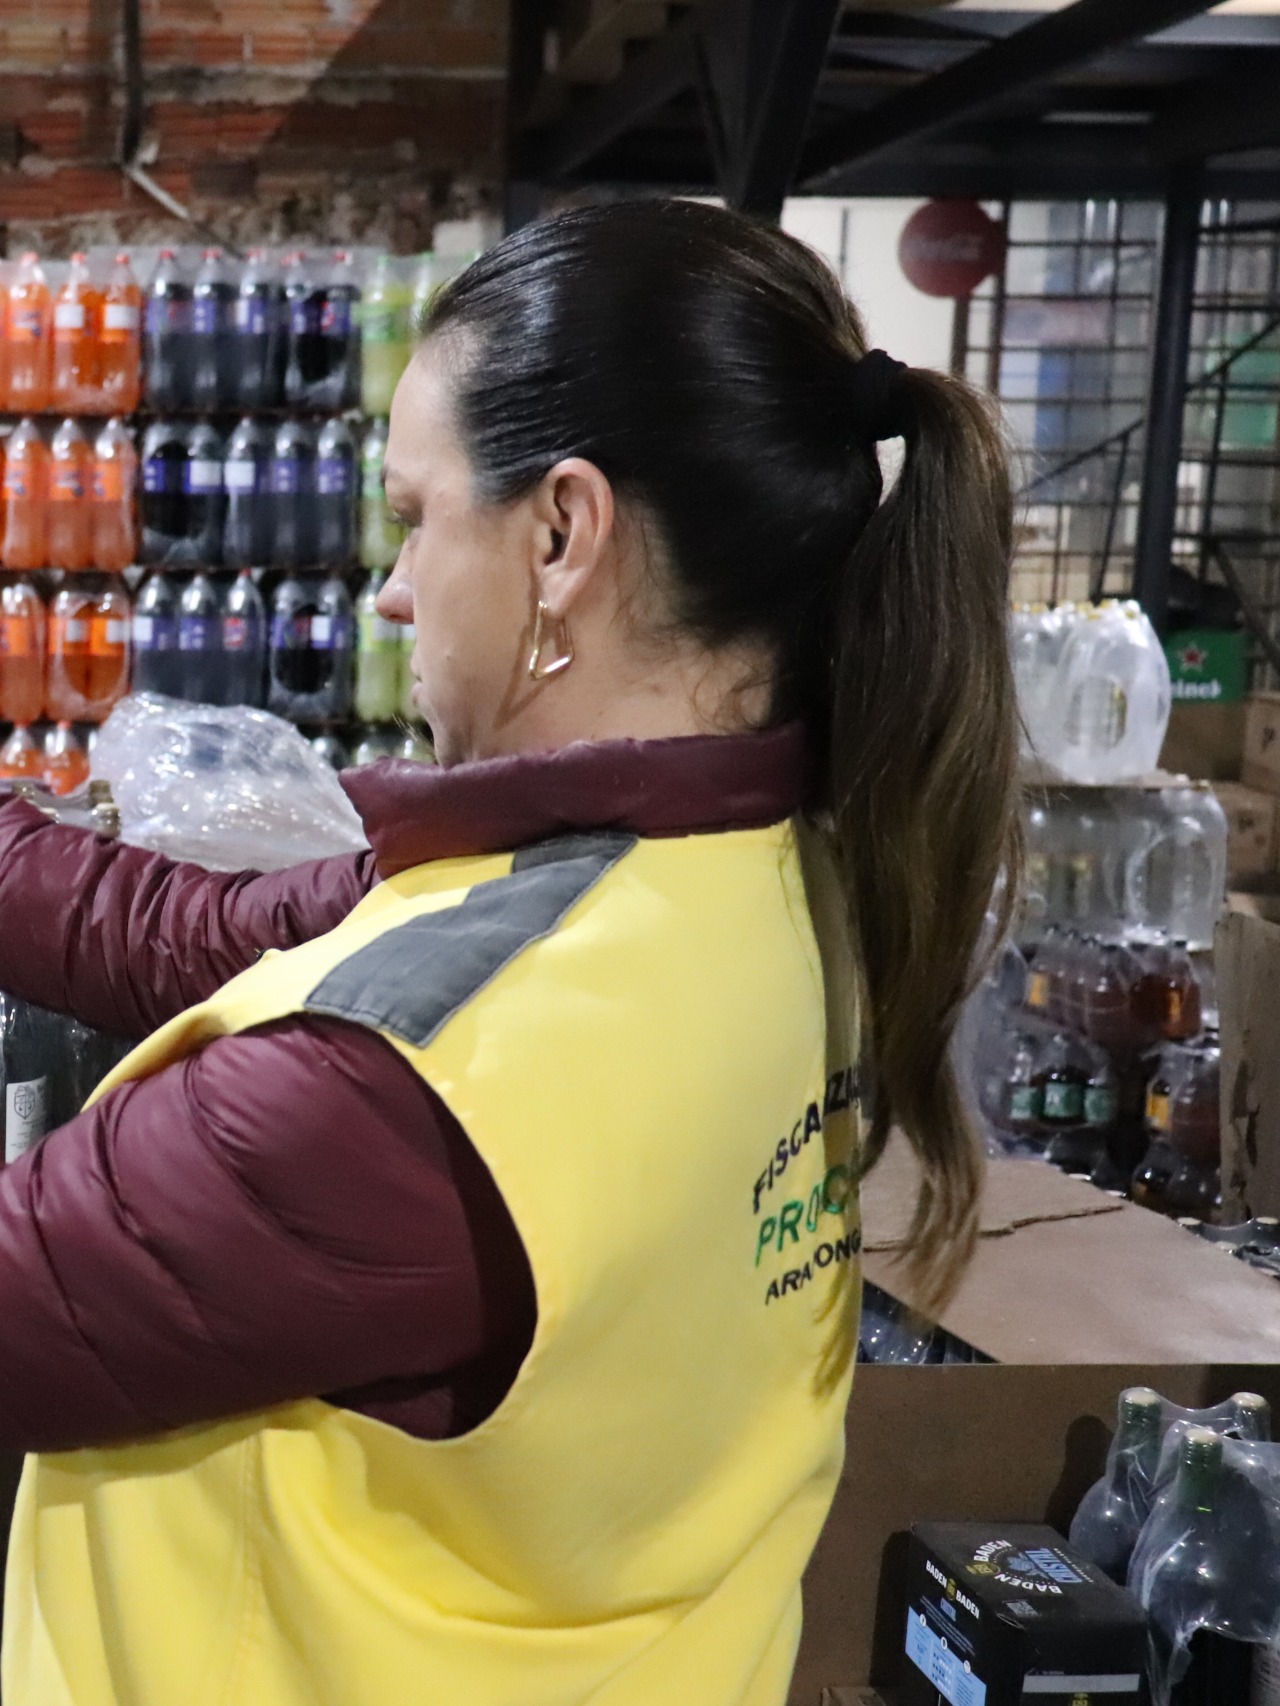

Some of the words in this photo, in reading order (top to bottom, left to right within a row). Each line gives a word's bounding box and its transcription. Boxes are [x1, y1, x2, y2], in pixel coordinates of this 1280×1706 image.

[973, 1538, 1013, 1563] BADEN
[926, 1559, 948, 1589] BADEN
[956, 1589, 980, 1620] BADEN
[994, 1572, 1063, 1594] BADEN
